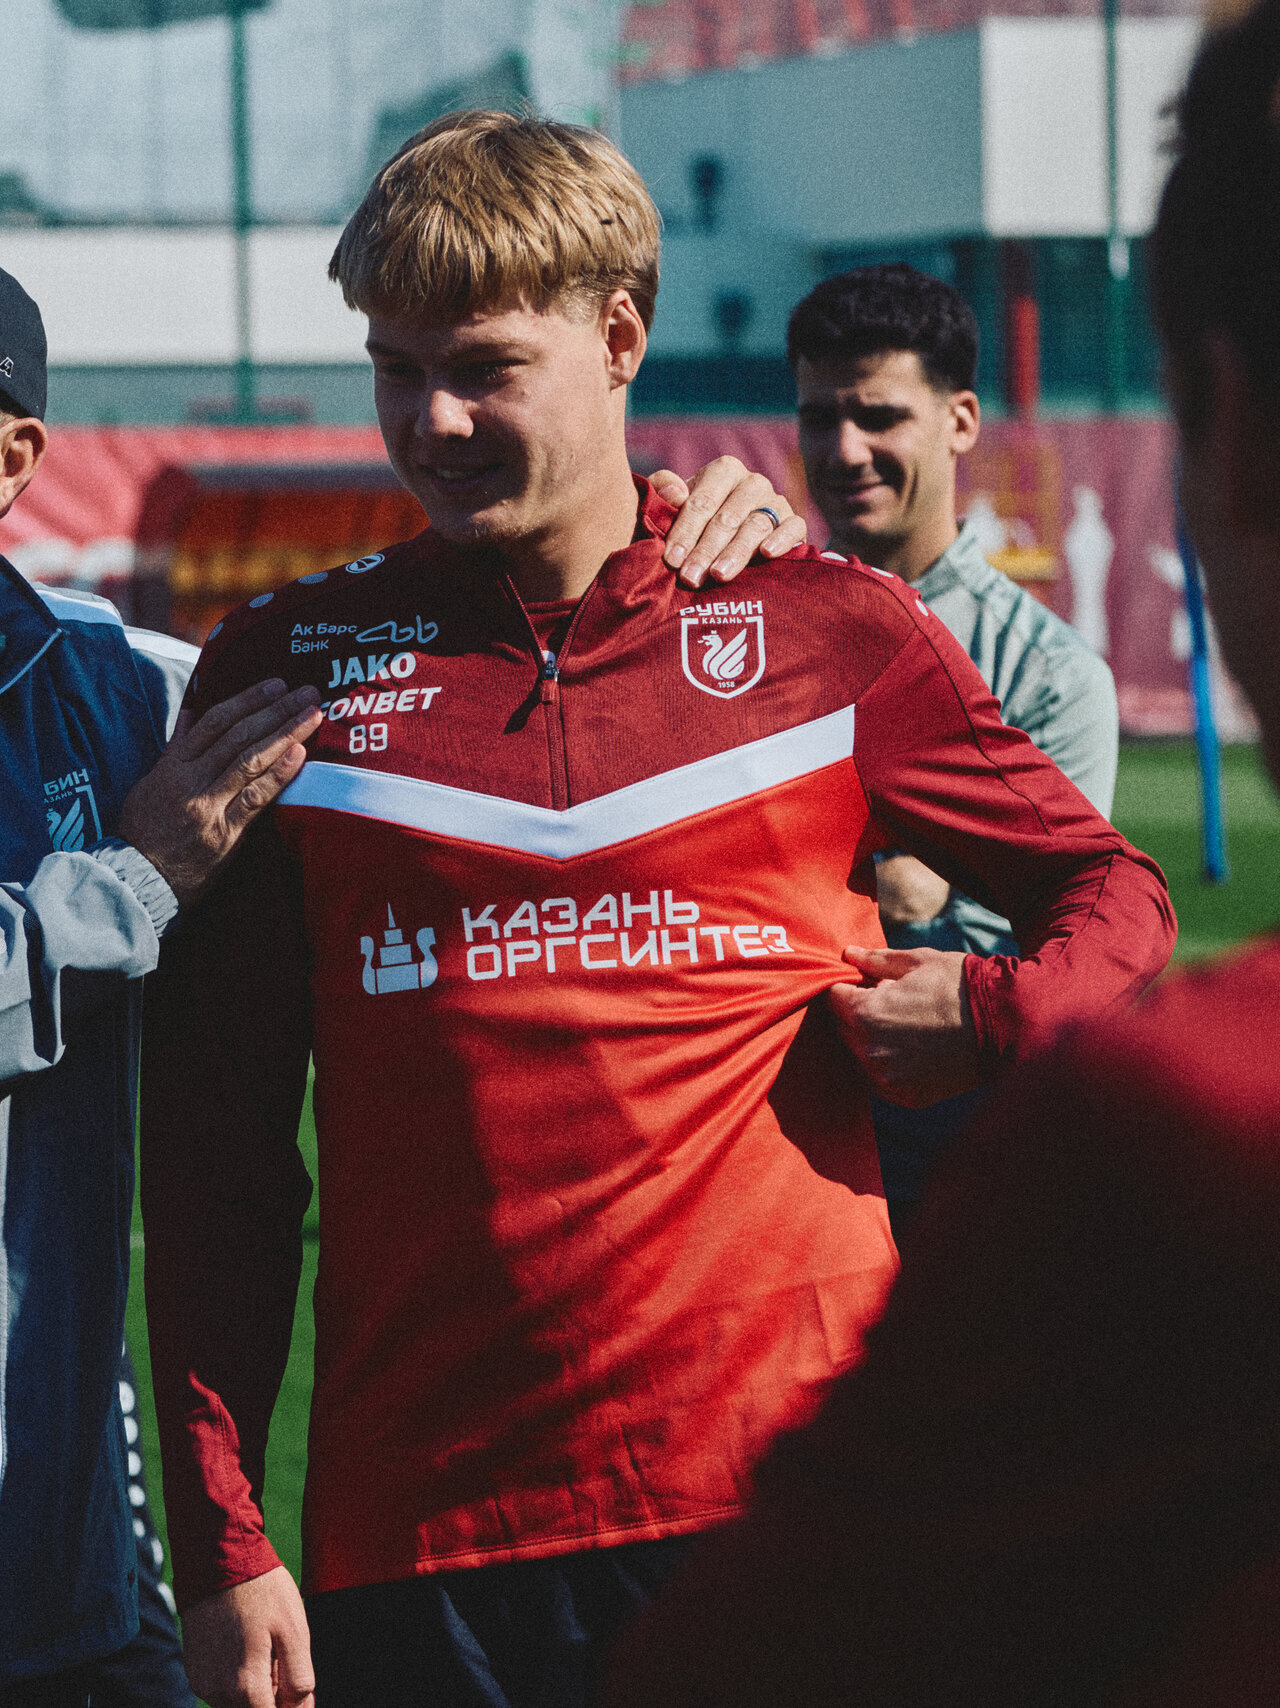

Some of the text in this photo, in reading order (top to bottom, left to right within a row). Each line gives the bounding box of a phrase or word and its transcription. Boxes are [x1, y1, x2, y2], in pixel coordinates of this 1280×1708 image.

[680, 601, 763, 616] РУБИН
[291, 623, 357, 636] Ак Барс
[291, 639, 329, 653] Банк
[328, 652, 416, 688] JAKO
[349, 723, 388, 754] 89
[43, 768, 89, 796] БИН
[43, 790, 73, 803] АЗАНЬ
[462, 890, 700, 942] КАЗАНЬ
[465, 925, 794, 981] ОРГСИНТЕЗ
